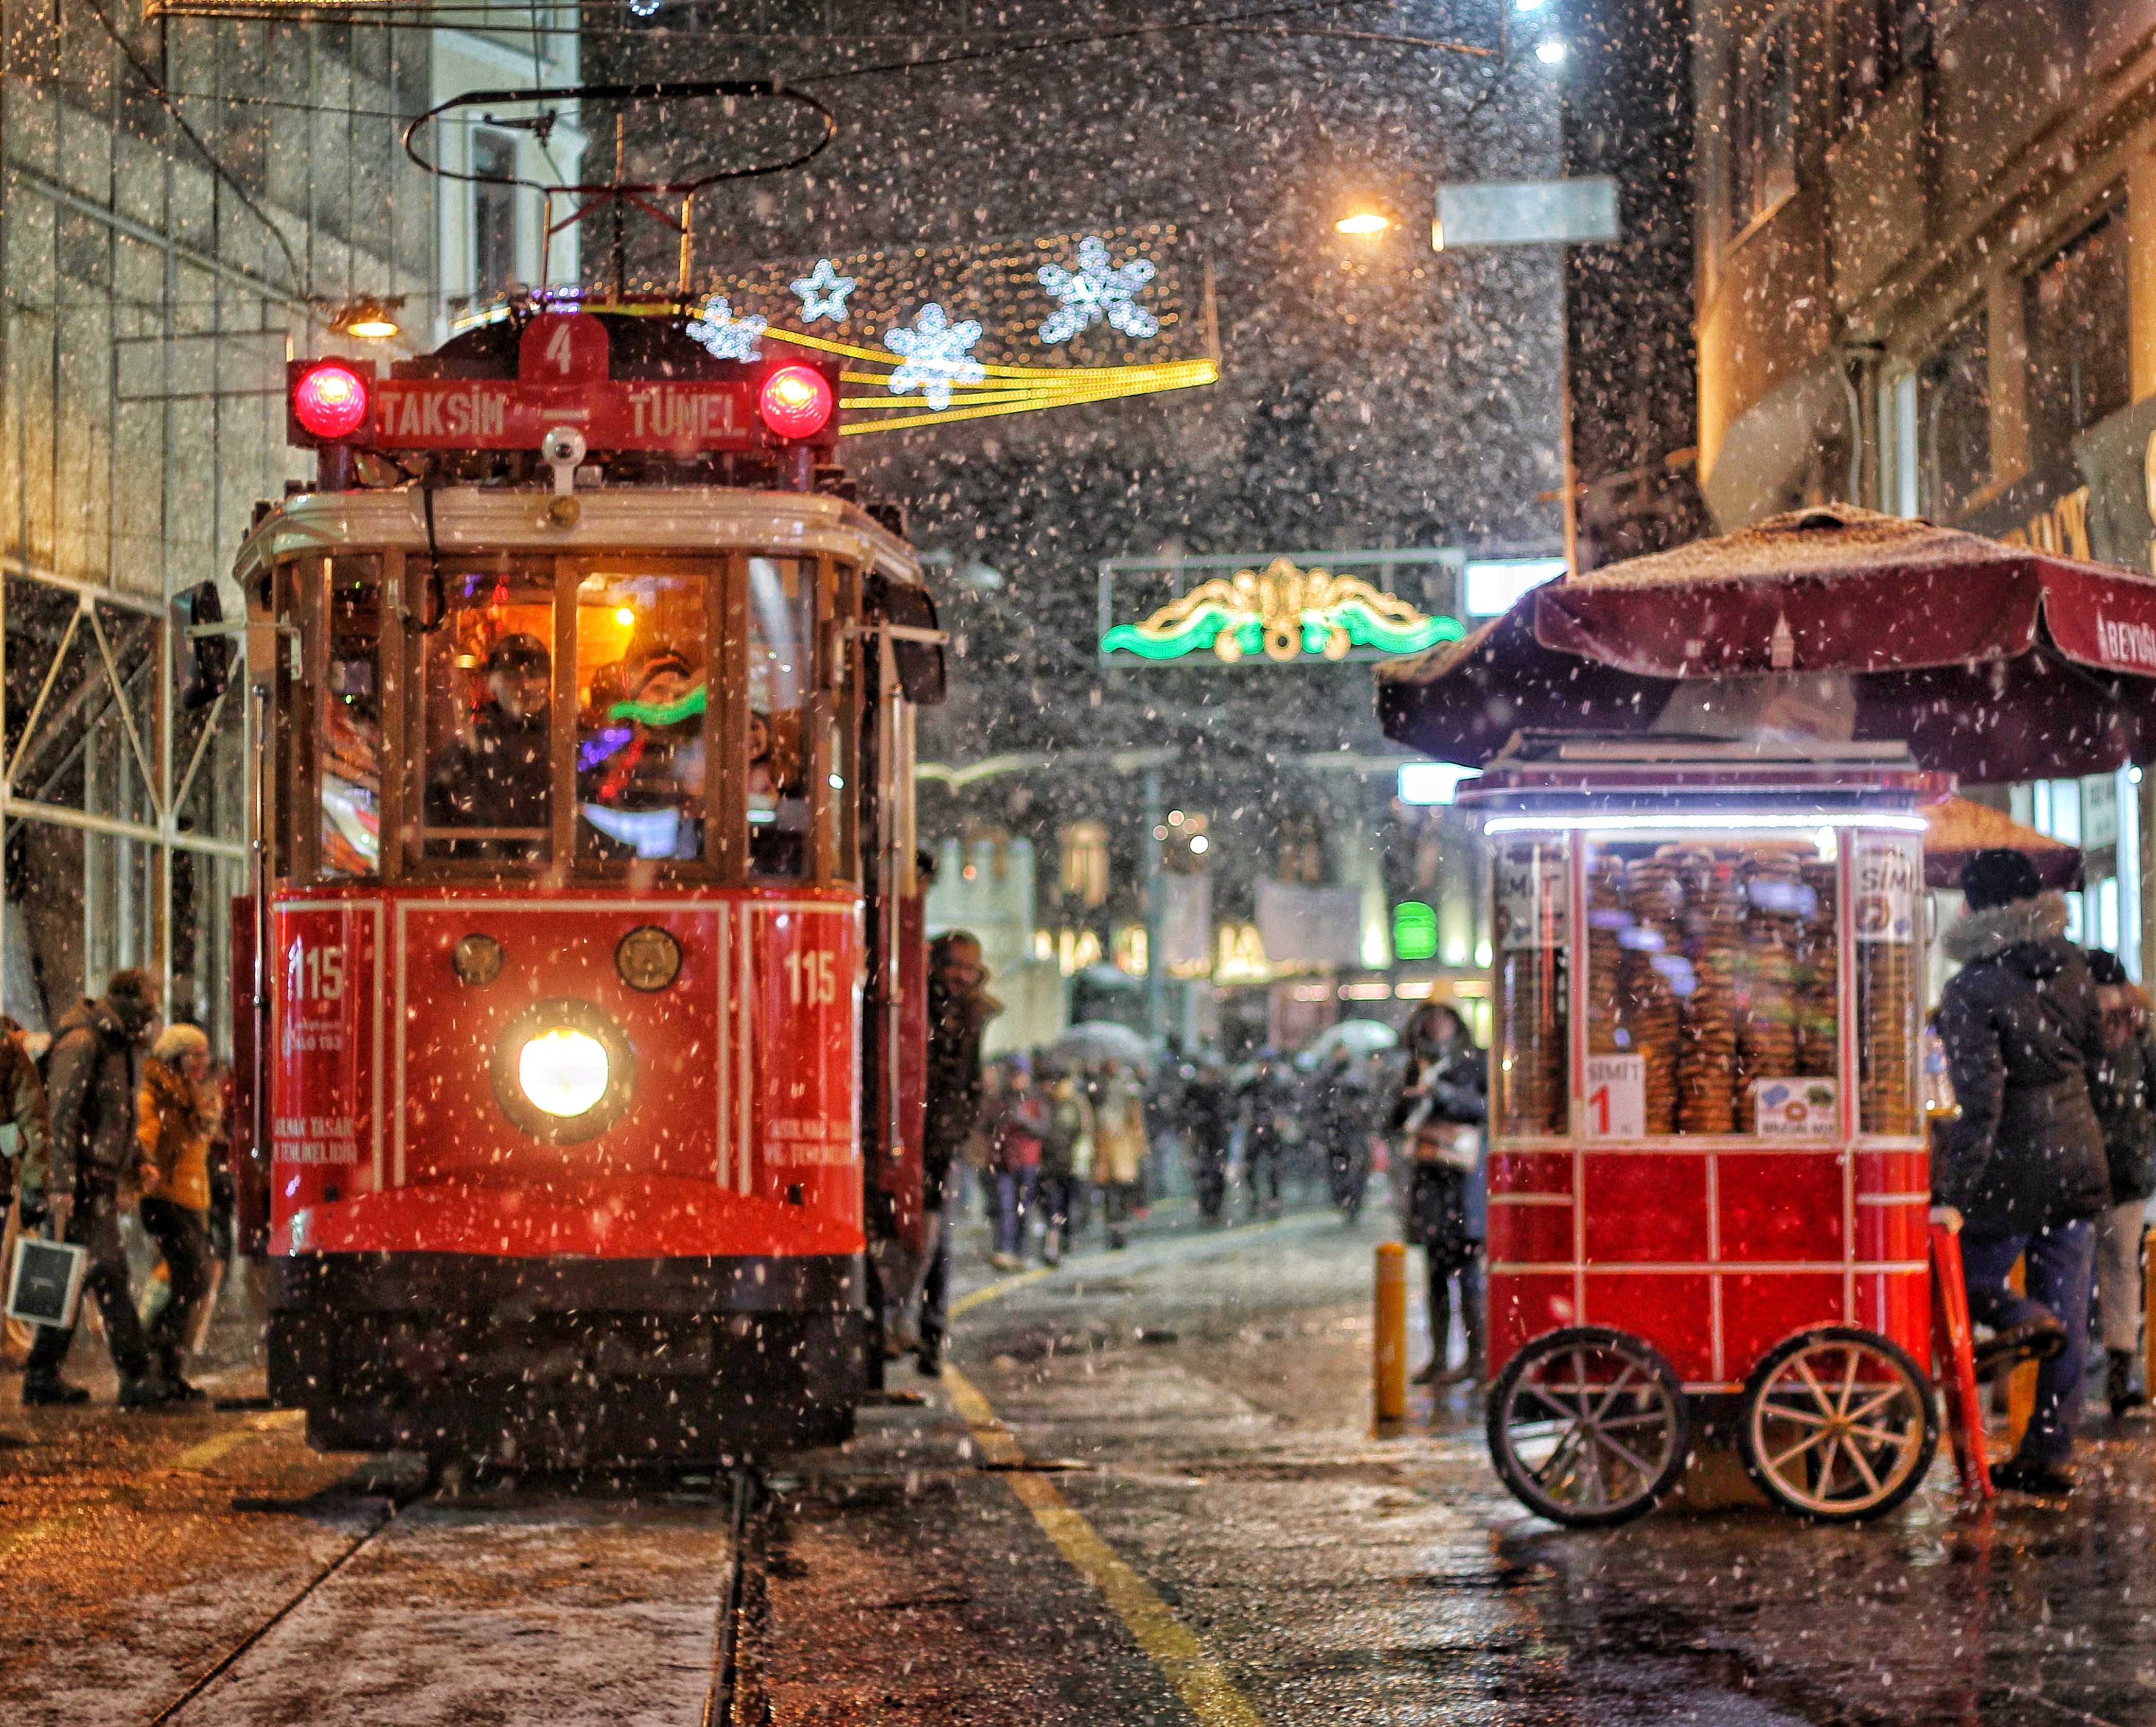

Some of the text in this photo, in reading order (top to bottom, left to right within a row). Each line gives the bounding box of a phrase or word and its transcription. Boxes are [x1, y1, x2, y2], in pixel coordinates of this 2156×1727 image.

[546, 323, 572, 375] 4
[378, 385, 747, 437] TAKSİM TÜNEL
[290, 943, 344, 1001] 115
[783, 950, 836, 1006] 115
[1588, 1084, 1610, 1136] 1
